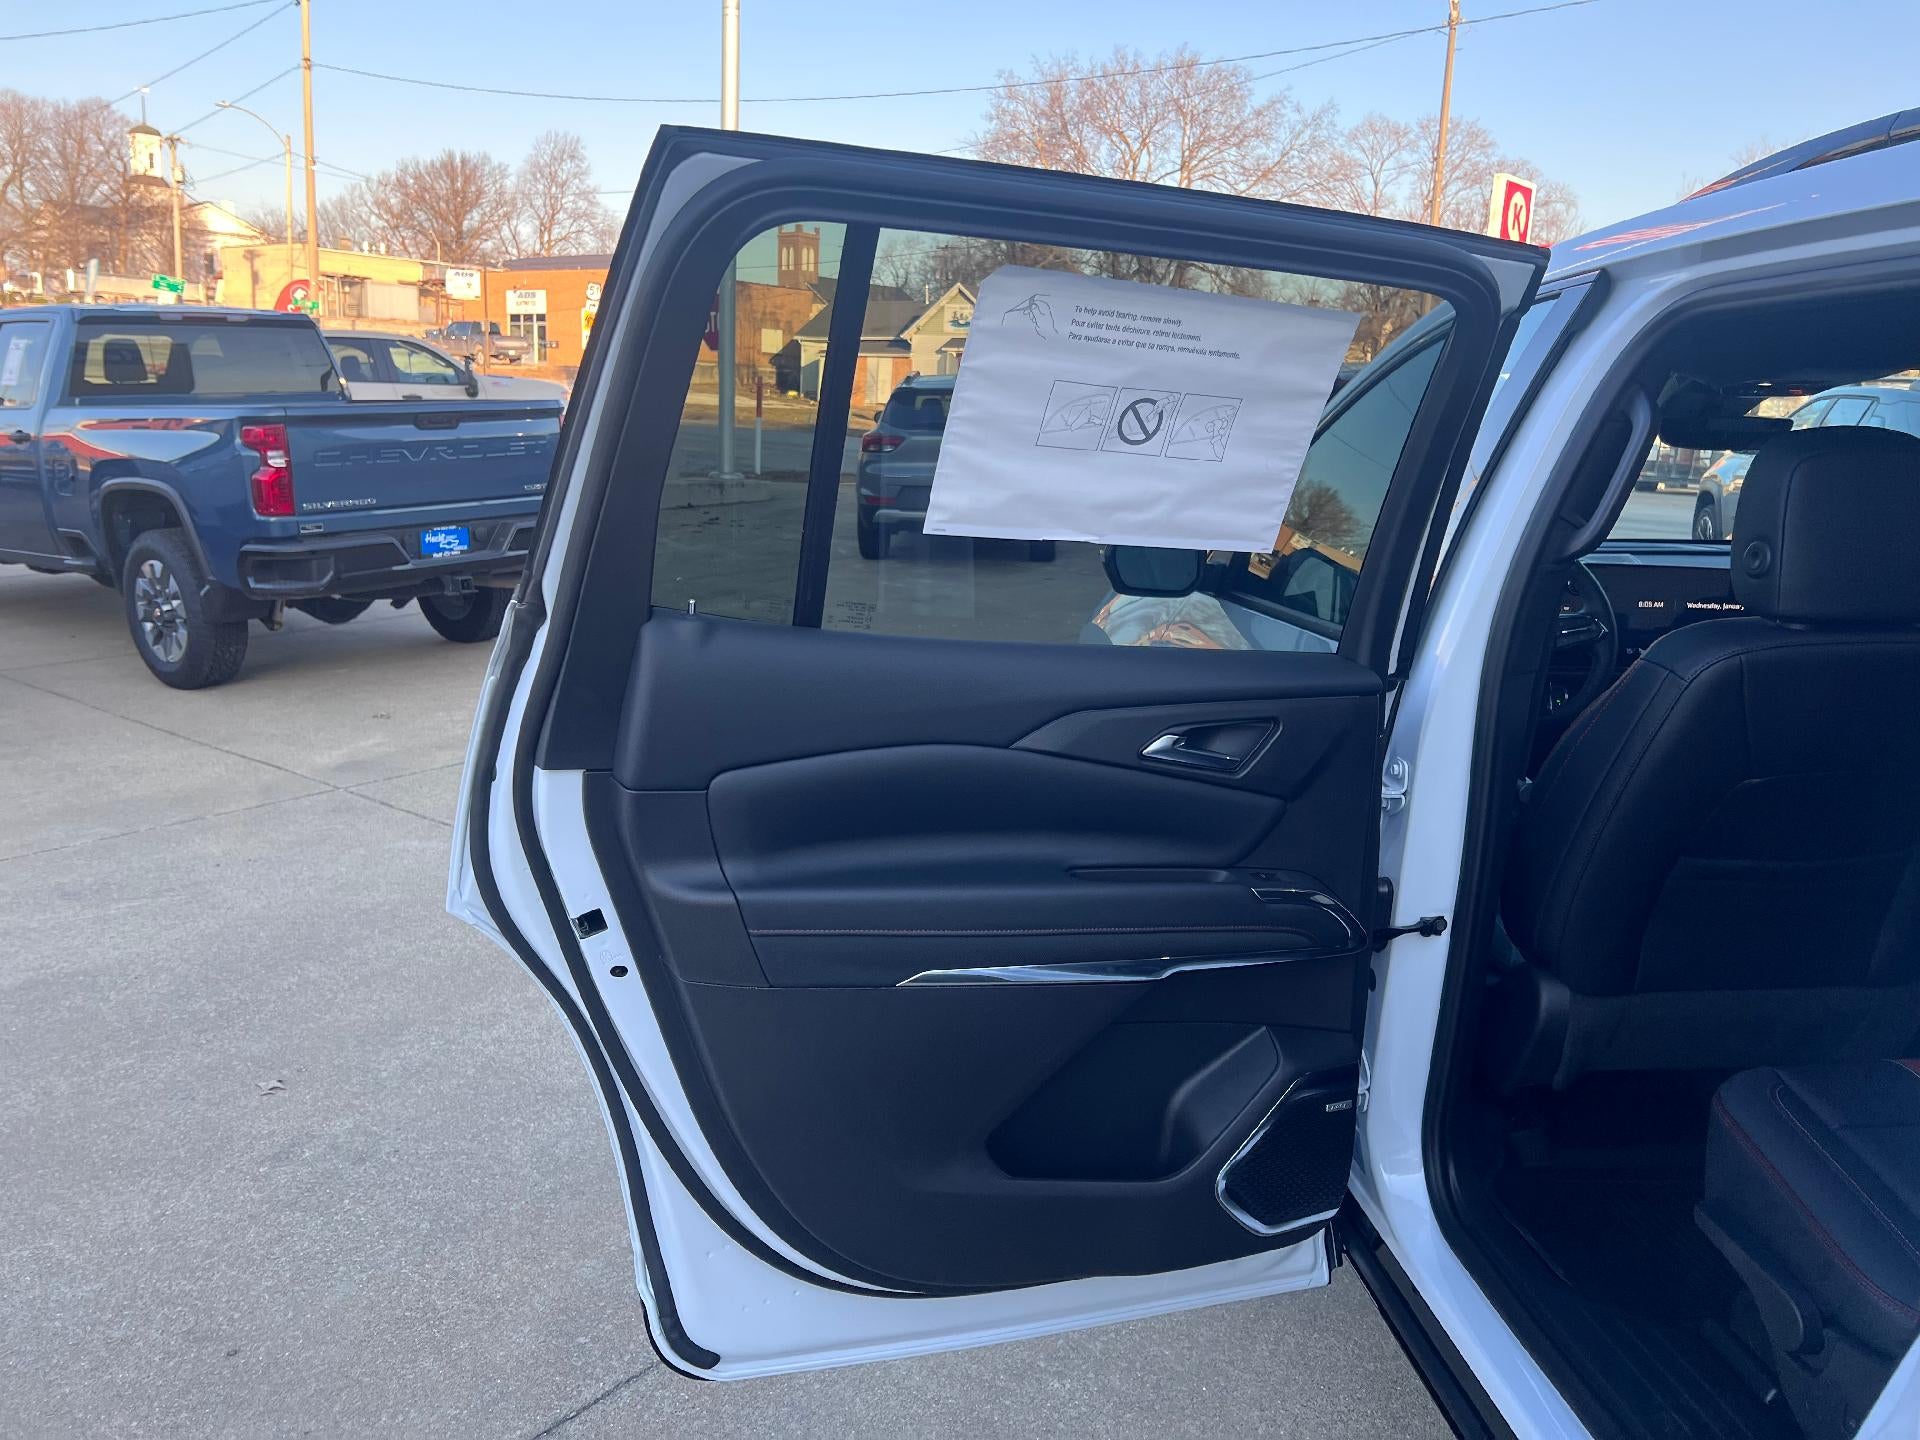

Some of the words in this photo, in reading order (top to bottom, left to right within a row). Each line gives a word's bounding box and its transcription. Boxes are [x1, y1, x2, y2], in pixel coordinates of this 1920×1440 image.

[1071, 318, 1087, 327] Pour
[1075, 305, 1083, 313] To
[1083, 306, 1098, 316] help
[1139, 314, 1162, 324] remove
[1068, 331, 1083, 341] Para
[1117, 338, 1135, 347] evitar
[1135, 340, 1147, 350] que
[314, 440, 548, 468] CHEVROLET
[302, 497, 377, 511] SILVERADO
[1686, 601, 1722, 610] Wednesday,
